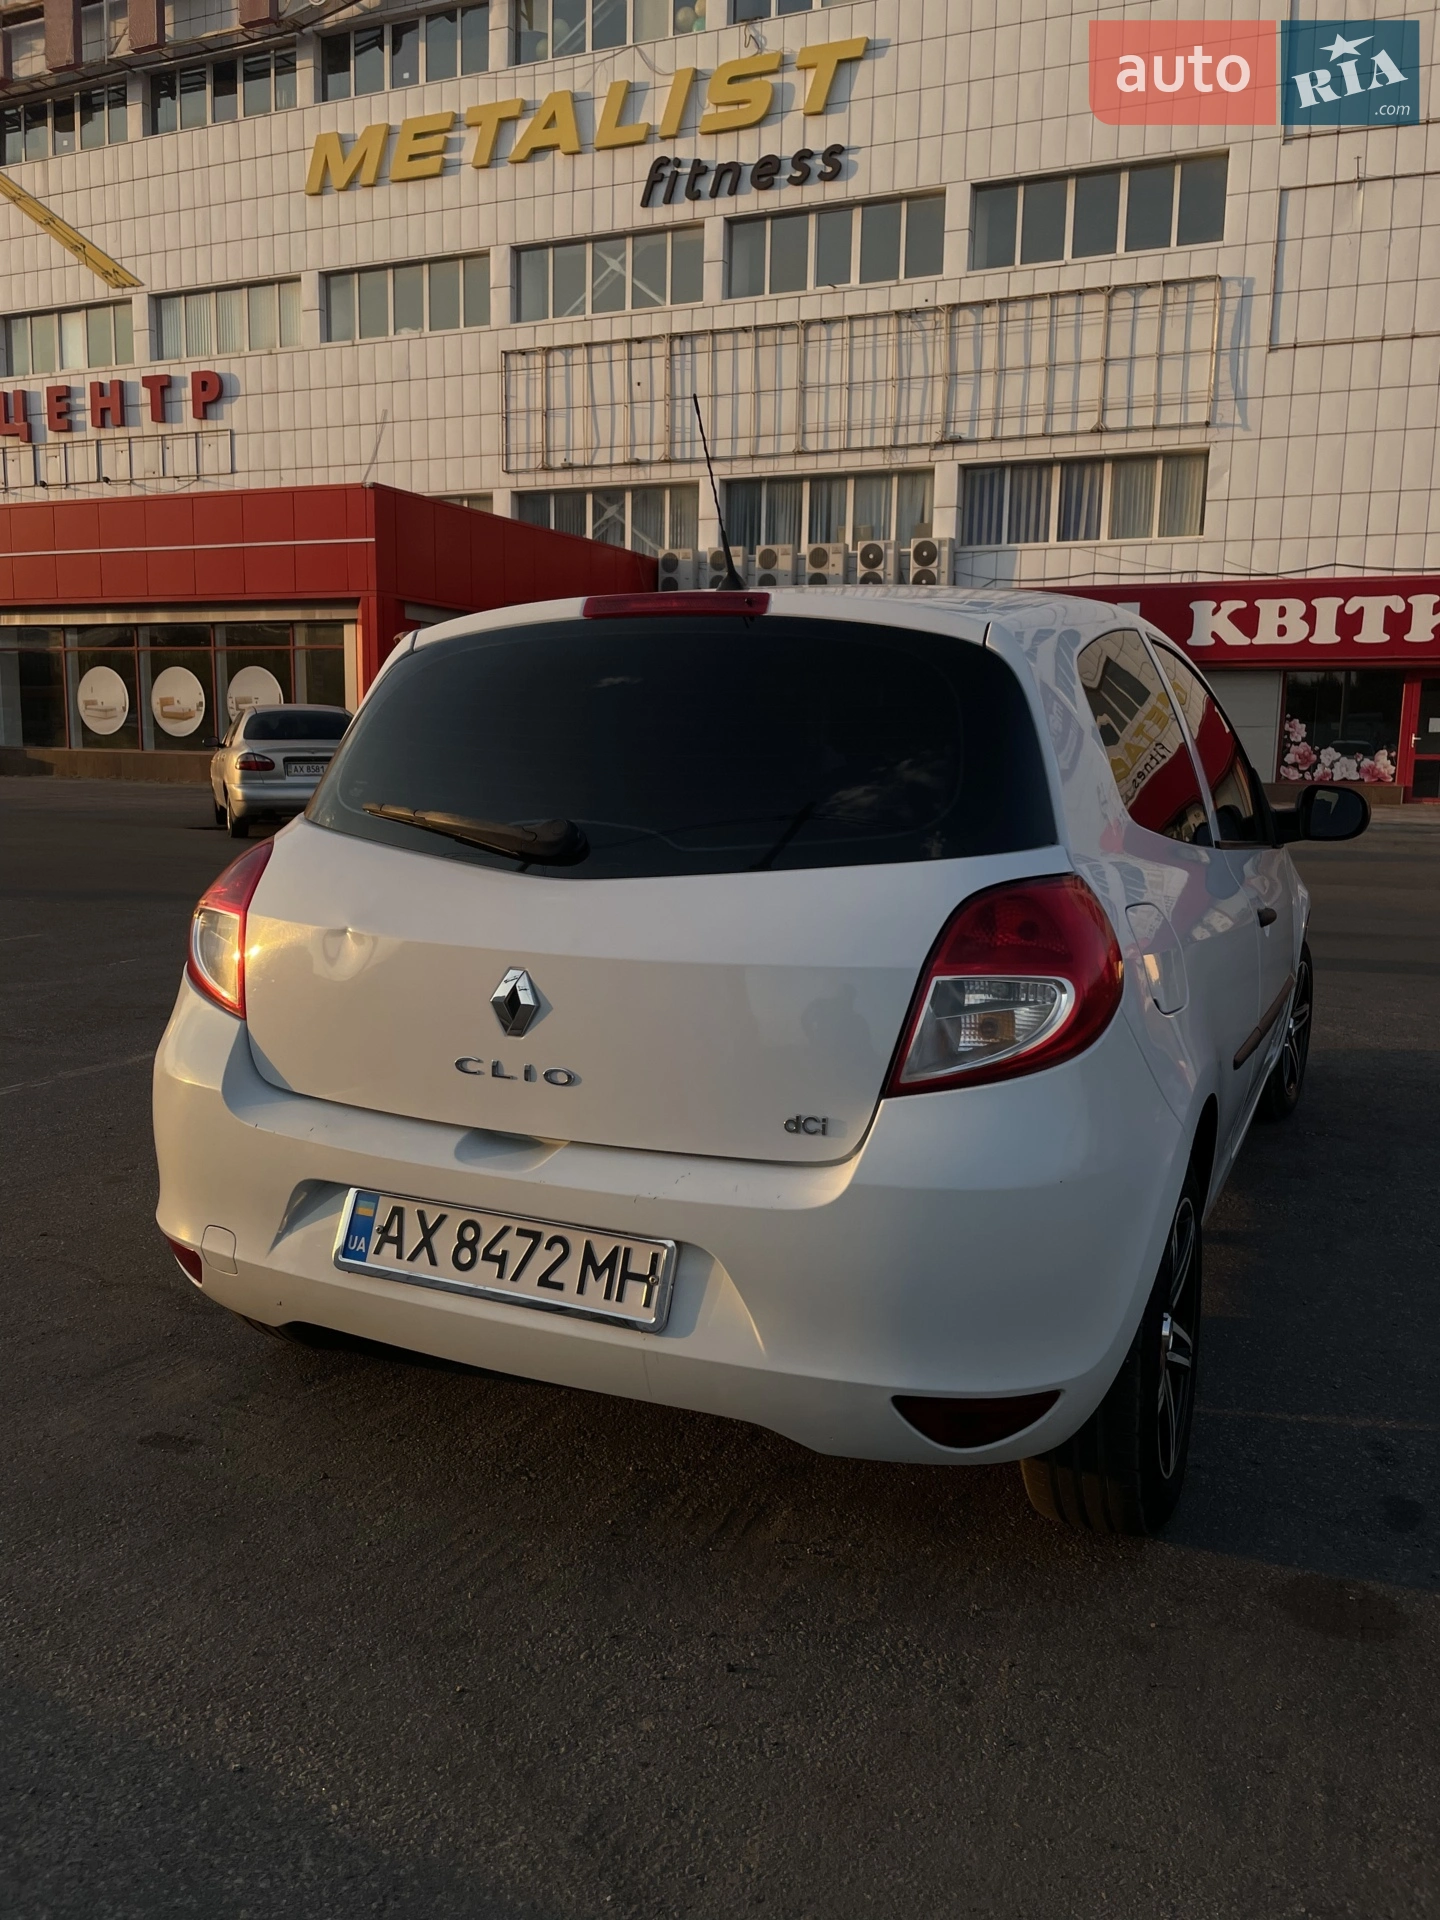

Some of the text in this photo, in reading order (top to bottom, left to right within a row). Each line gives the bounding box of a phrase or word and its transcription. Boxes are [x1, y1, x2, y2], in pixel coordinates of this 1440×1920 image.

[304, 36, 870, 196] METALIST
[640, 143, 846, 208] fitness
[0, 370, 224, 443] ЦЕНТР
[454, 1055, 576, 1087] CLIO
[783, 1113, 829, 1136] dCi
[347, 1205, 660, 1308] UA AX 8472 MH
